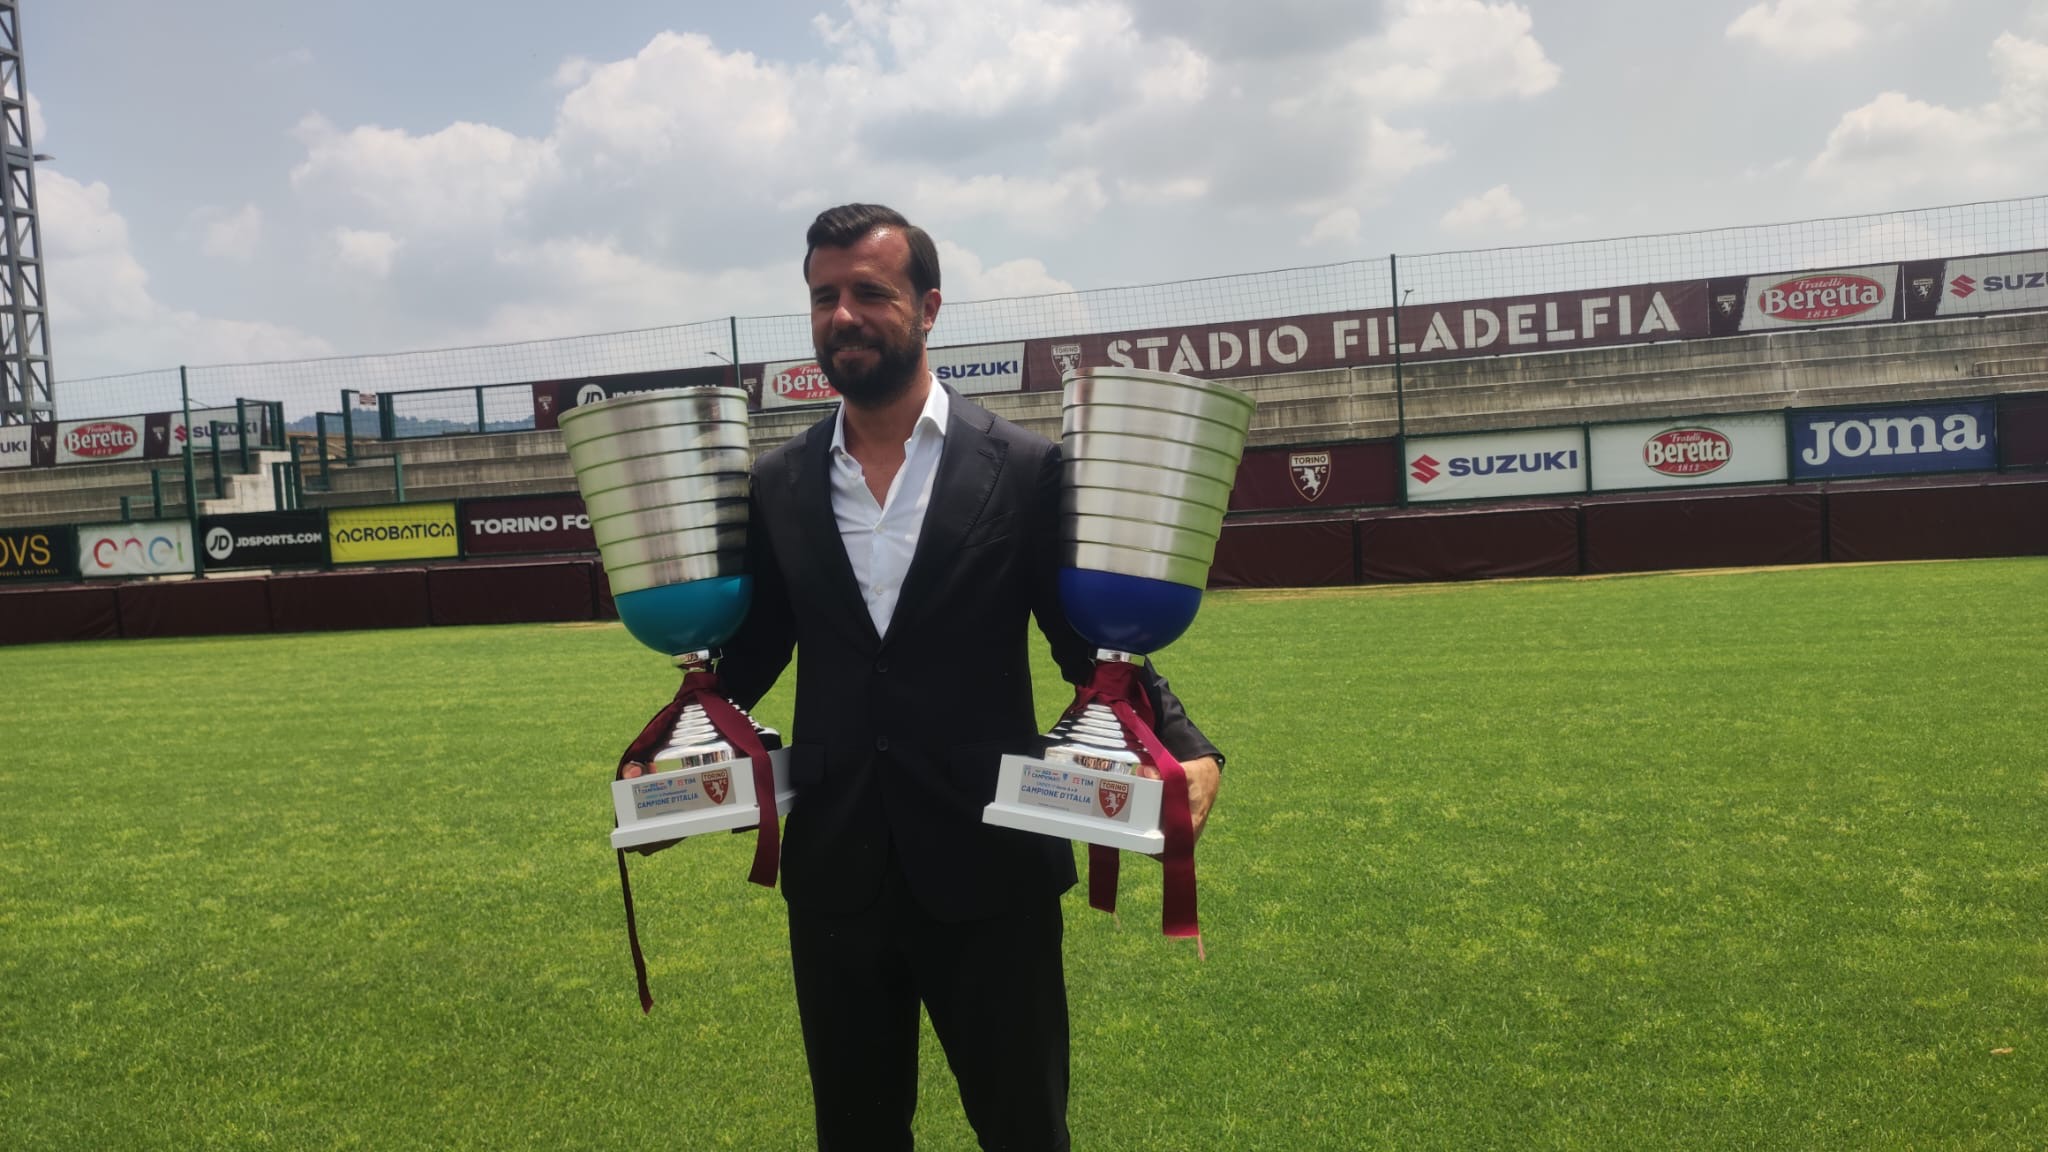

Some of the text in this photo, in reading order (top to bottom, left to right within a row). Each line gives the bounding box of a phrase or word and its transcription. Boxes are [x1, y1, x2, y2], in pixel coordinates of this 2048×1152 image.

[1984, 272, 2048, 291] SUZ
[1763, 283, 1880, 314] Beretta
[1807, 309, 1838, 319] 1812
[1107, 291, 1680, 373] STADIO FILADELFIA
[937, 360, 1018, 379] SUZUKI
[776, 373, 829, 395] Bere
[67, 429, 135, 452] Beretta
[1293, 456, 1327, 465] TORINO
[1648, 437, 1728, 467] Beretta
[1447, 450, 1578, 477] SUZUKI
[336, 522, 455, 543] ACROBATICA
[470, 514, 591, 535] TORINO FC
[209, 535, 230, 552] JD
[236, 533, 322, 547] JDSPORTS.COM
[1021, 784, 1059, 798] CAMPIONE
[1060, 793, 1091, 804] D'ITALIA
